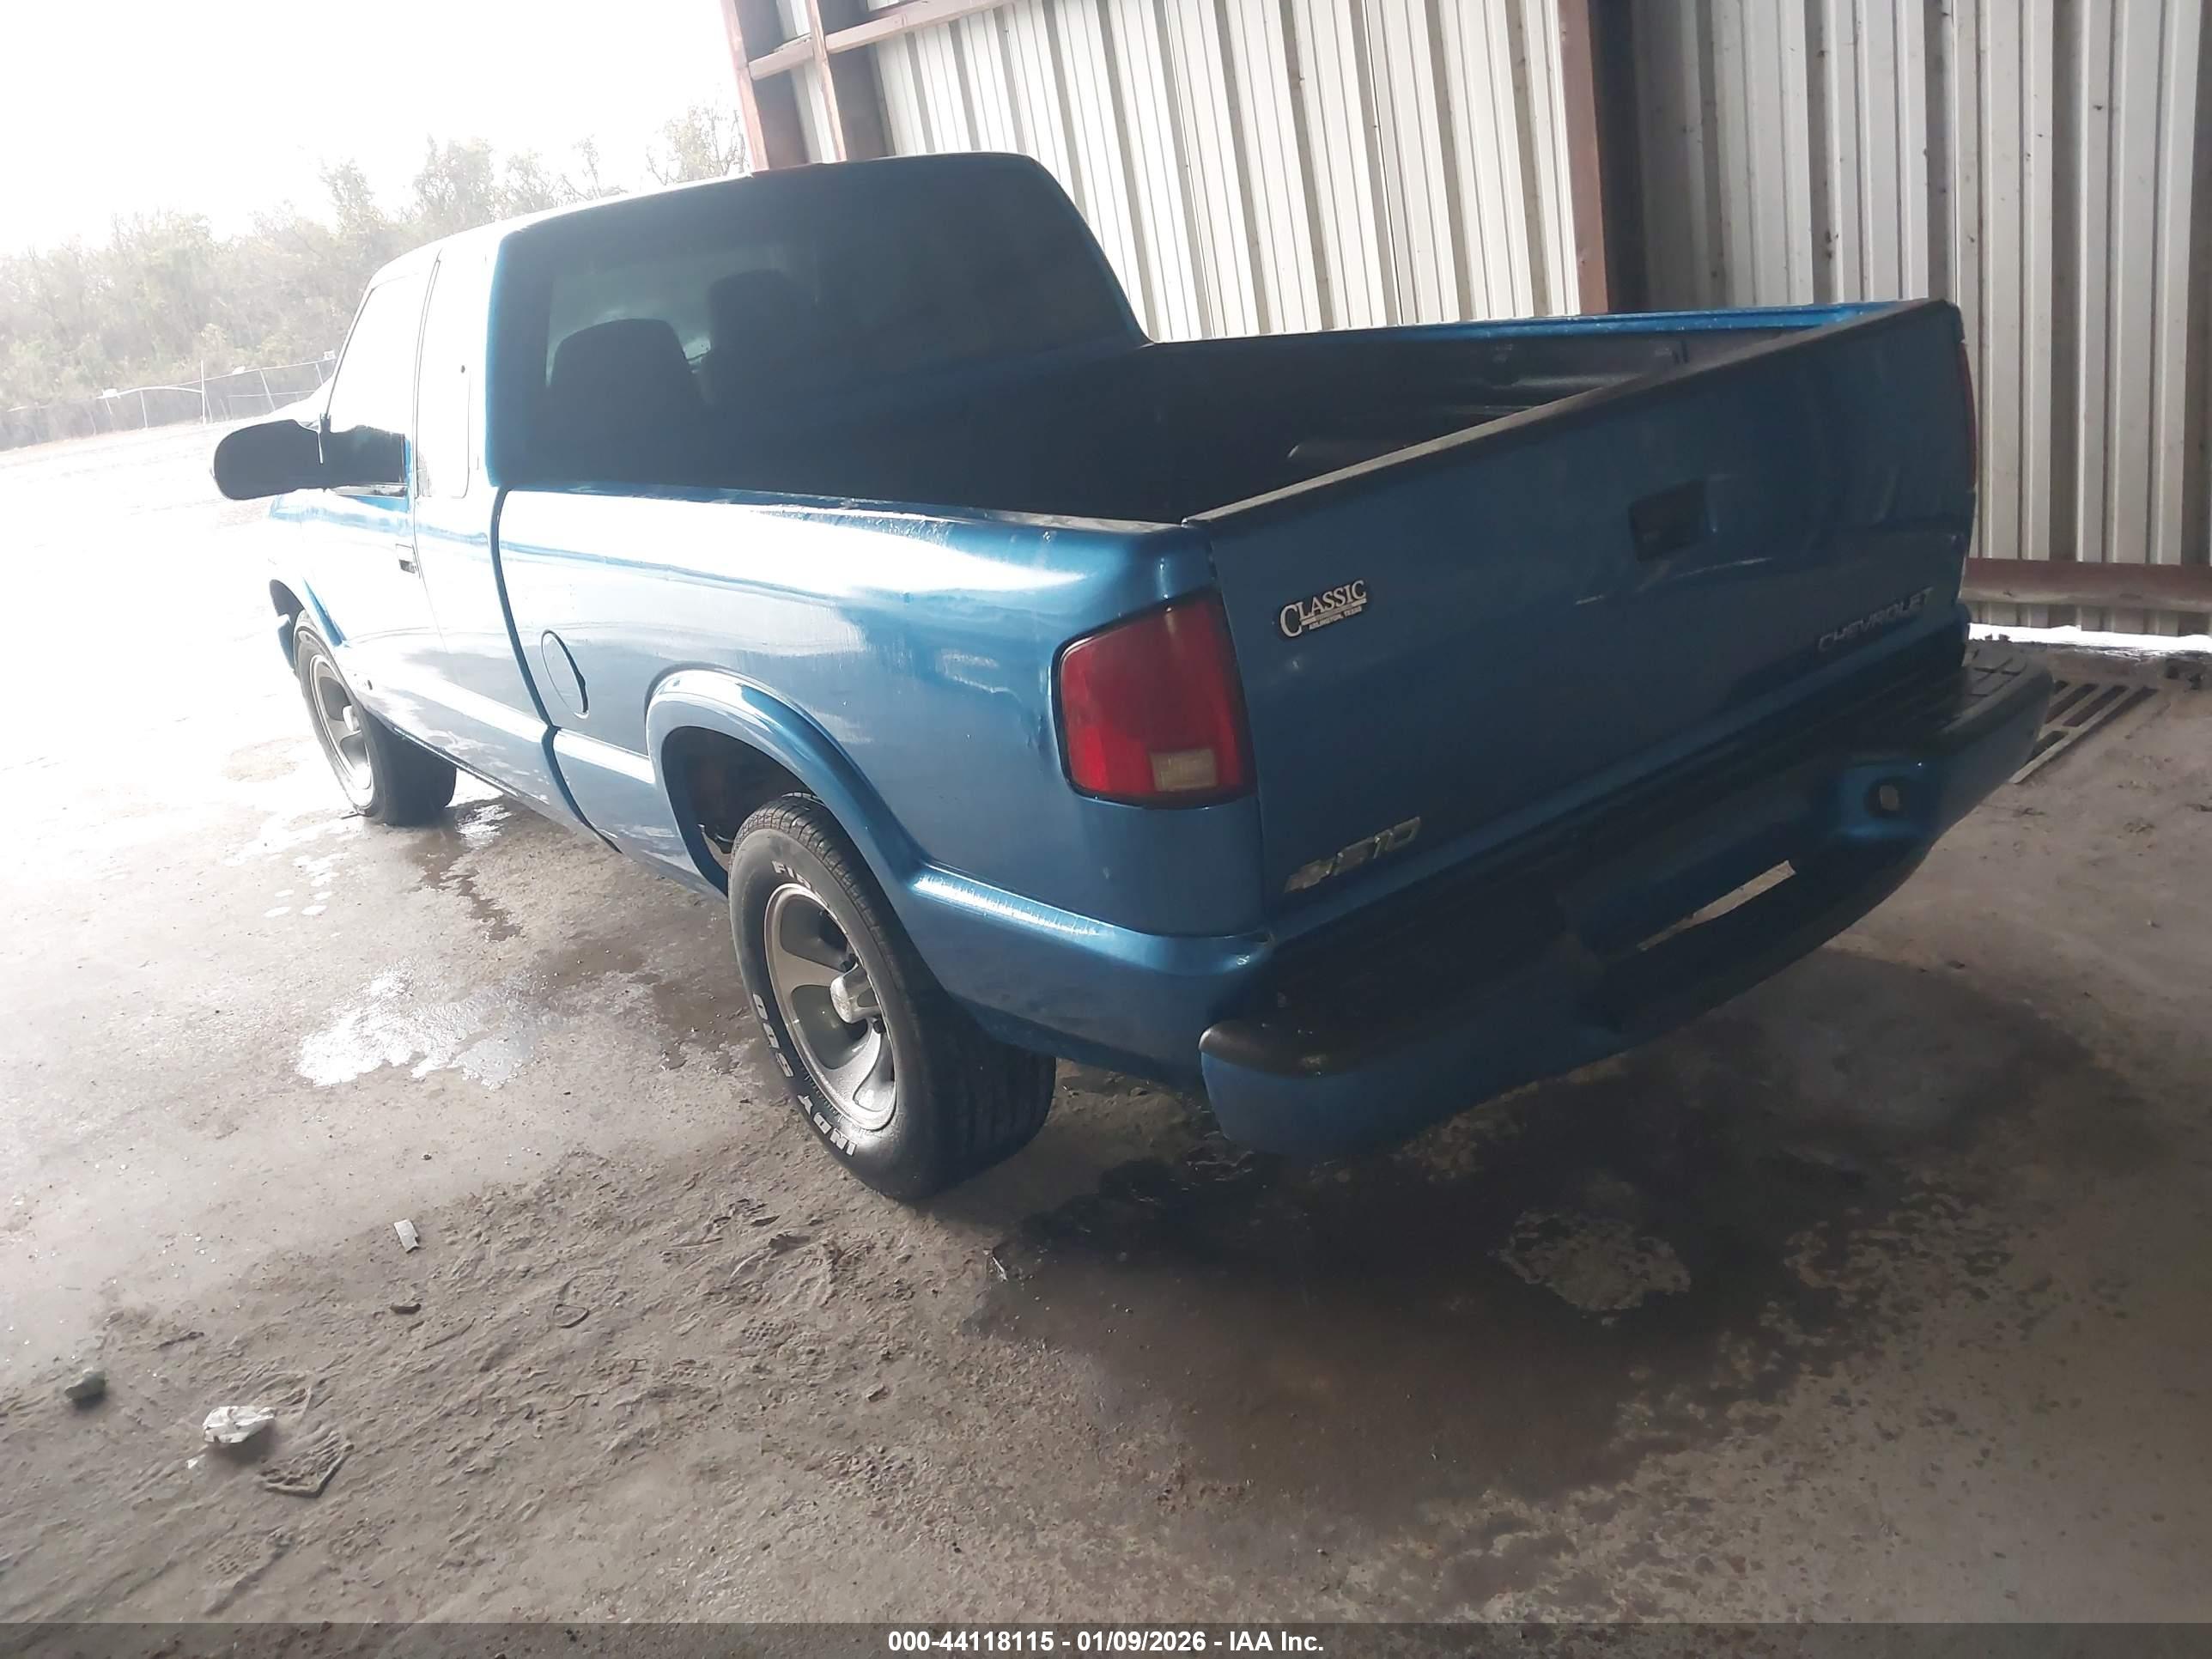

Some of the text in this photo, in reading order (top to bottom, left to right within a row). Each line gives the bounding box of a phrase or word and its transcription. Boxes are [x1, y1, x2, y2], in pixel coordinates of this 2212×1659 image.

[1280, 580, 1366, 637] CLASSIC
[1818, 586, 1934, 652] CHEVROLET
[797, 1094, 858, 1157] INDY
